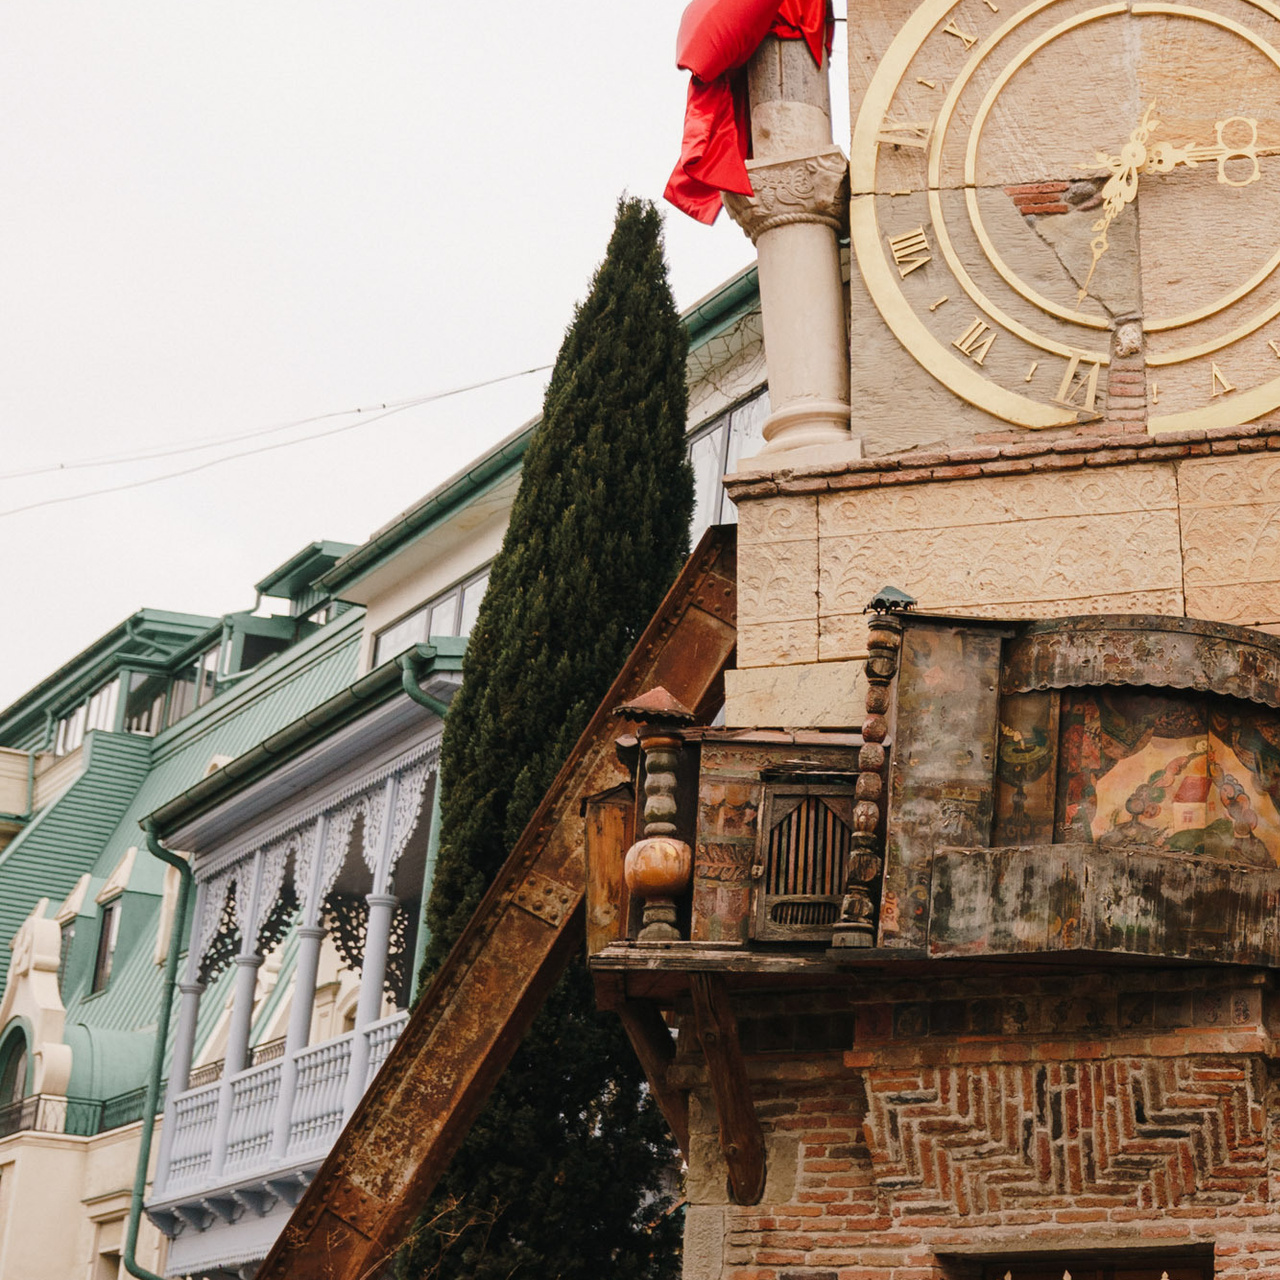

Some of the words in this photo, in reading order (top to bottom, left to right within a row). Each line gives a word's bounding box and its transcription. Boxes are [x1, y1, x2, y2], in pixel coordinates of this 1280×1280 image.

[942, 18, 979, 51] X
[874, 113, 936, 153] IX
[888, 225, 932, 279] VIII
[951, 315, 998, 366] VII
[1049, 349, 1100, 414] VI
[1211, 361, 1237, 397] V
